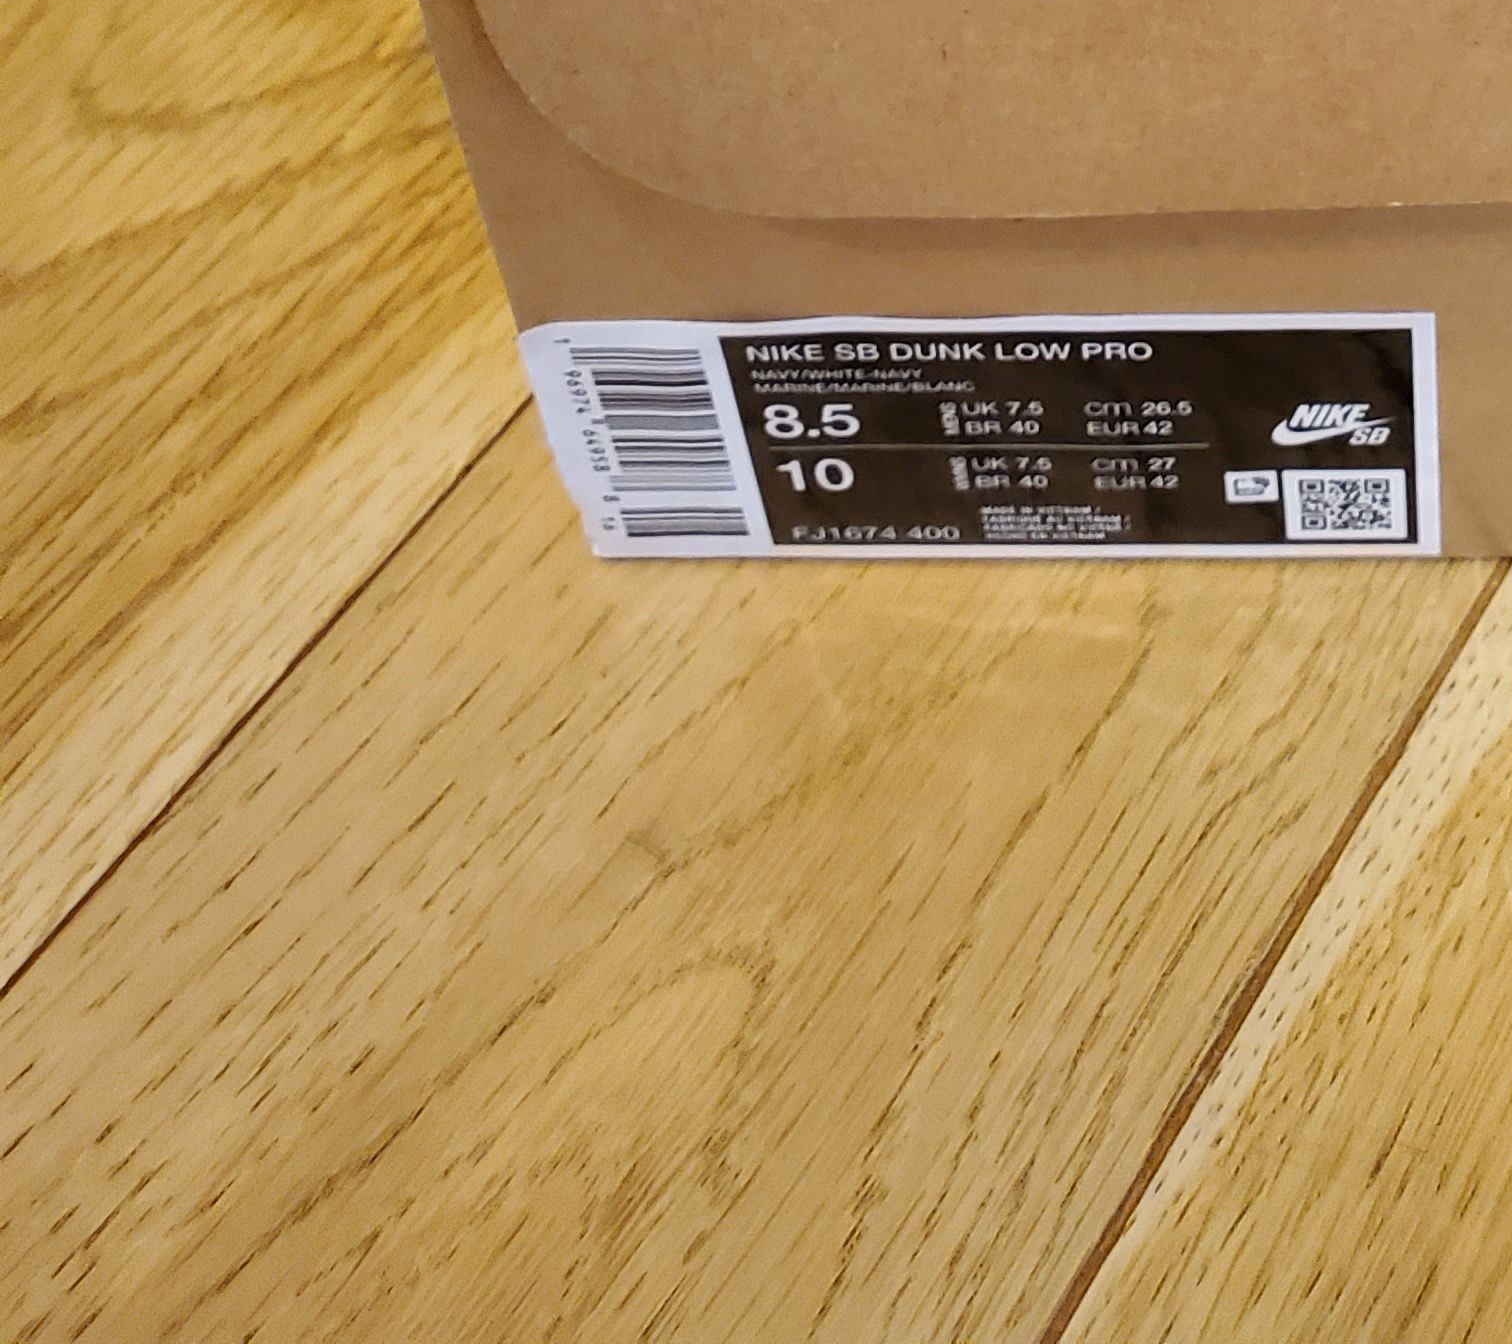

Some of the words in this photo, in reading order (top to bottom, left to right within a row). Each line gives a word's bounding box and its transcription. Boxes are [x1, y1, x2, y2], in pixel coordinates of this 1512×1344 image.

[746, 343, 824, 361] NIKE
[834, 343, 880, 361] SB
[888, 342, 986, 361] DUNK
[994, 342, 1071, 360] LOW
[1081, 342, 1153, 360] PRO
[961, 401, 999, 416] UK
[1004, 400, 1045, 416] 7.5
[1140, 400, 1193, 416] 26.5
[1288, 403, 1370, 429] NIKE
[763, 403, 861, 439] 8.5
[964, 420, 1003, 435] BR
[1007, 420, 1040, 435] 40
[1086, 420, 1140, 436] EUR
[1142, 420, 1174, 435] 42
[1349, 427, 1391, 445] SB
[971, 457, 1009, 472] UK
[1015, 457, 1052, 472] 7.5
[1147, 456, 1177, 472] 27
[775, 457, 854, 492] 10
[974, 474, 1011, 489] BR
[1017, 474, 1049, 489] 40
[1094, 474, 1147, 490] EUR
[1149, 474, 1180, 489] 42
[791, 525, 897, 540] FJ1674
[906, 525, 961, 540] 400
